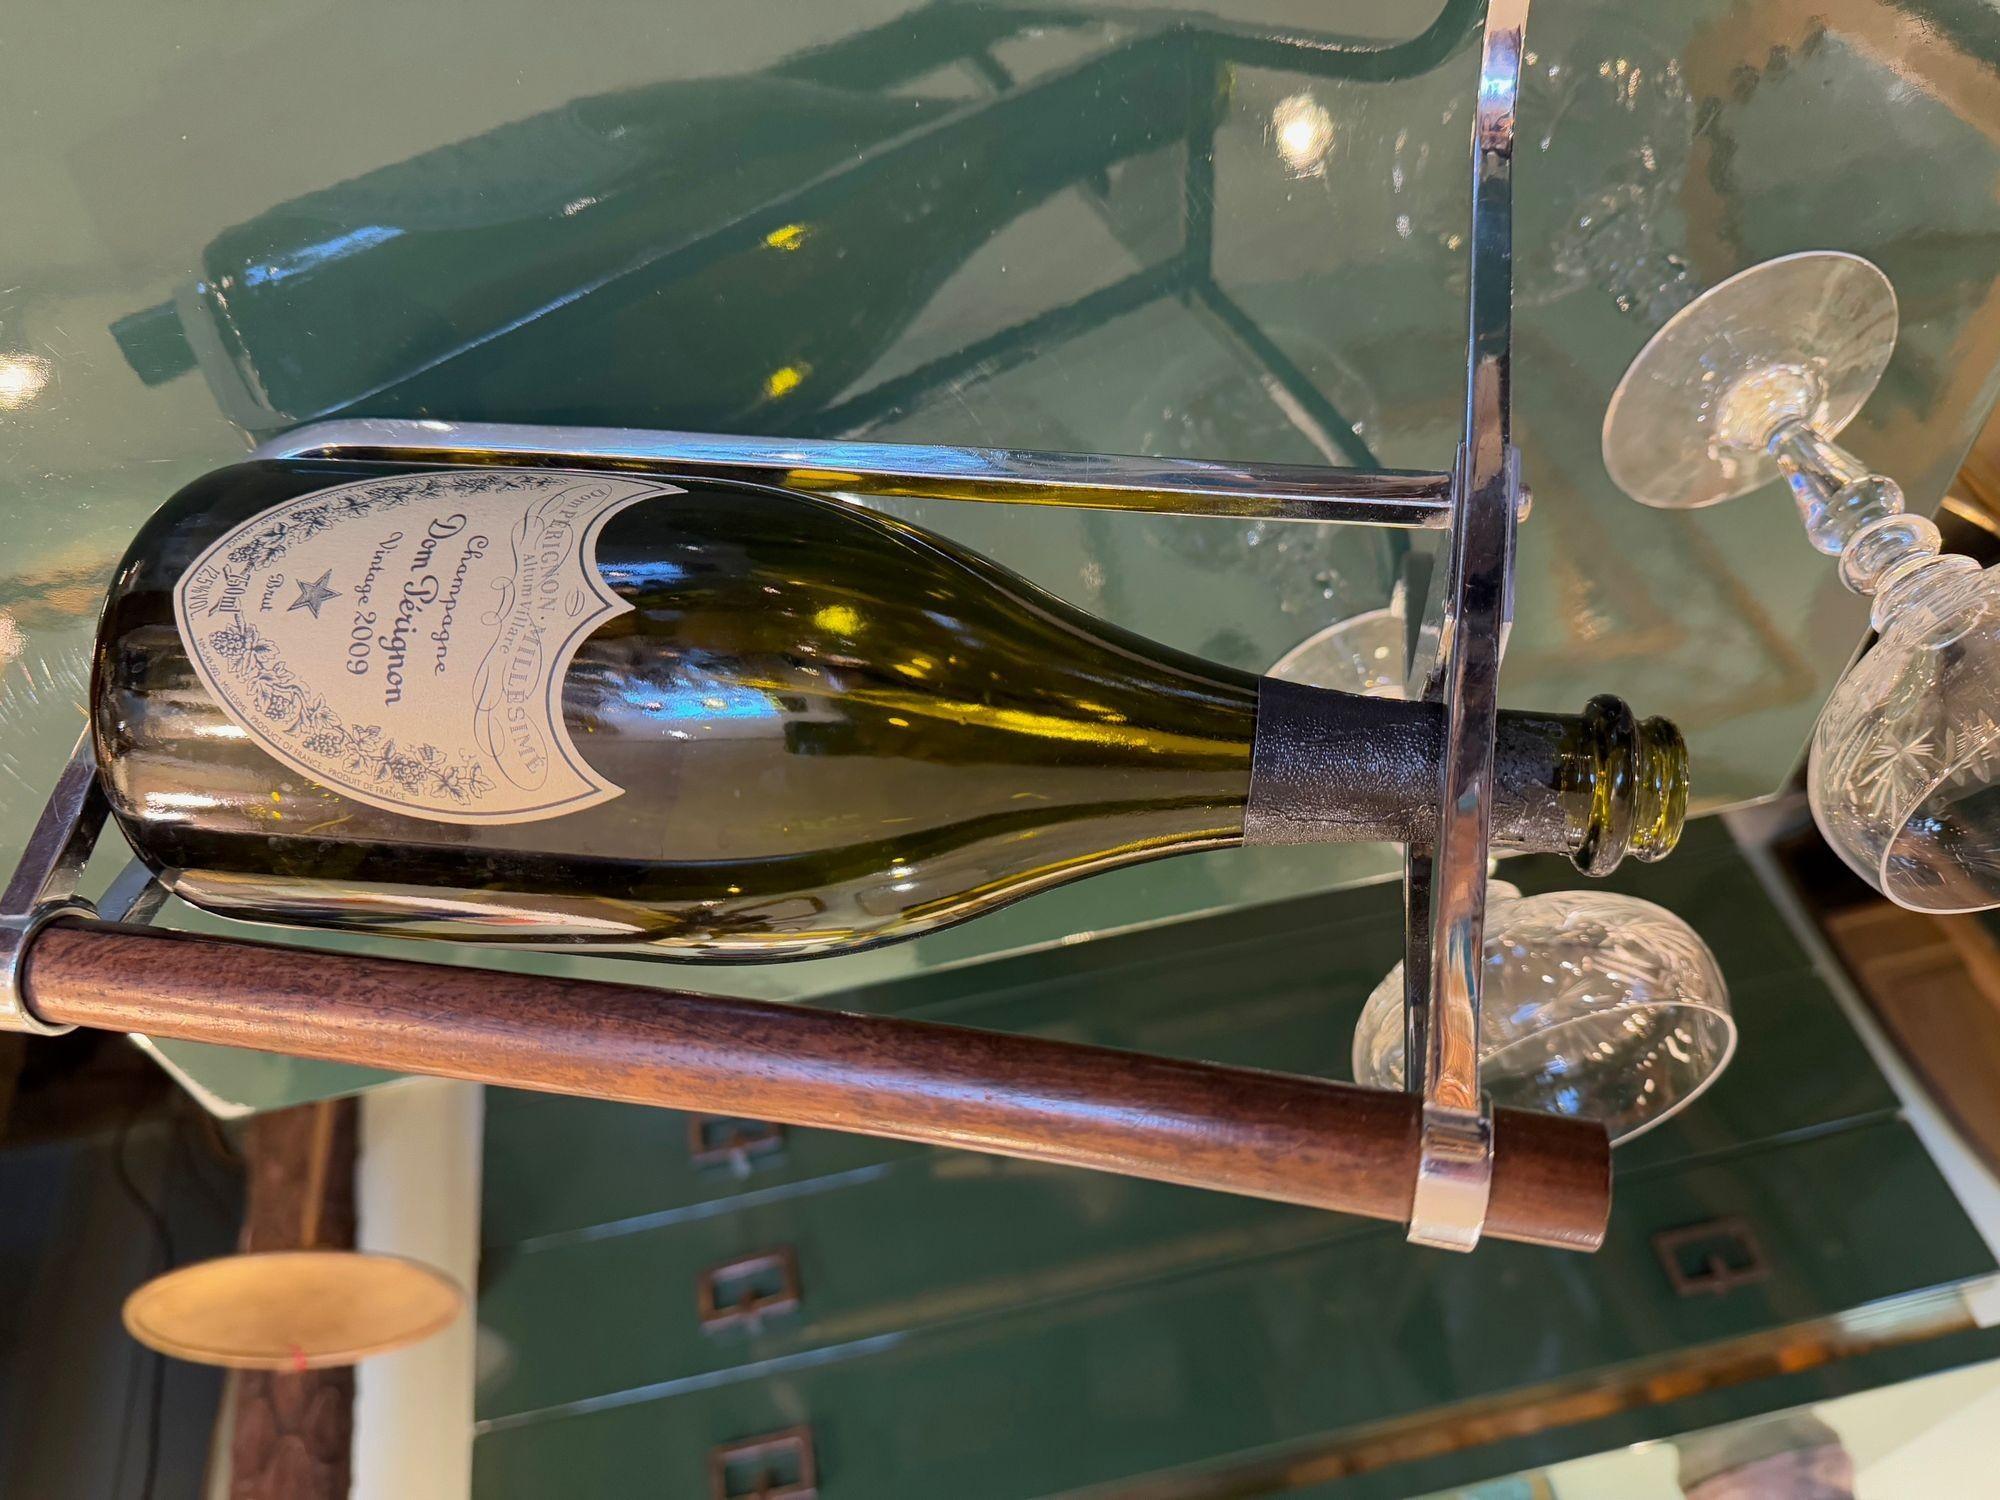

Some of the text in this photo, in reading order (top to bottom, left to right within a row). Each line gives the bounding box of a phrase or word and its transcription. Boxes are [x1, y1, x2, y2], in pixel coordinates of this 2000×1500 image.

[569, 488, 608, 509] Dom
[227, 528, 254, 549] FRANCE
[260, 573, 285, 613] Brut
[347, 531, 404, 675] Vintage 2009
[431, 535, 489, 677] Champagne
[521, 553, 538, 597] Altum
[378, 514, 467, 706] Dom Pérignon
[250, 715, 283, 746] PRODUCT
[283, 741, 294, 754] OF
[293, 749, 322, 768] FRANCE
[328, 767, 361, 787] PRODUIT
[363, 781, 374, 792] DE
[375, 784, 408, 801] FRANCE
